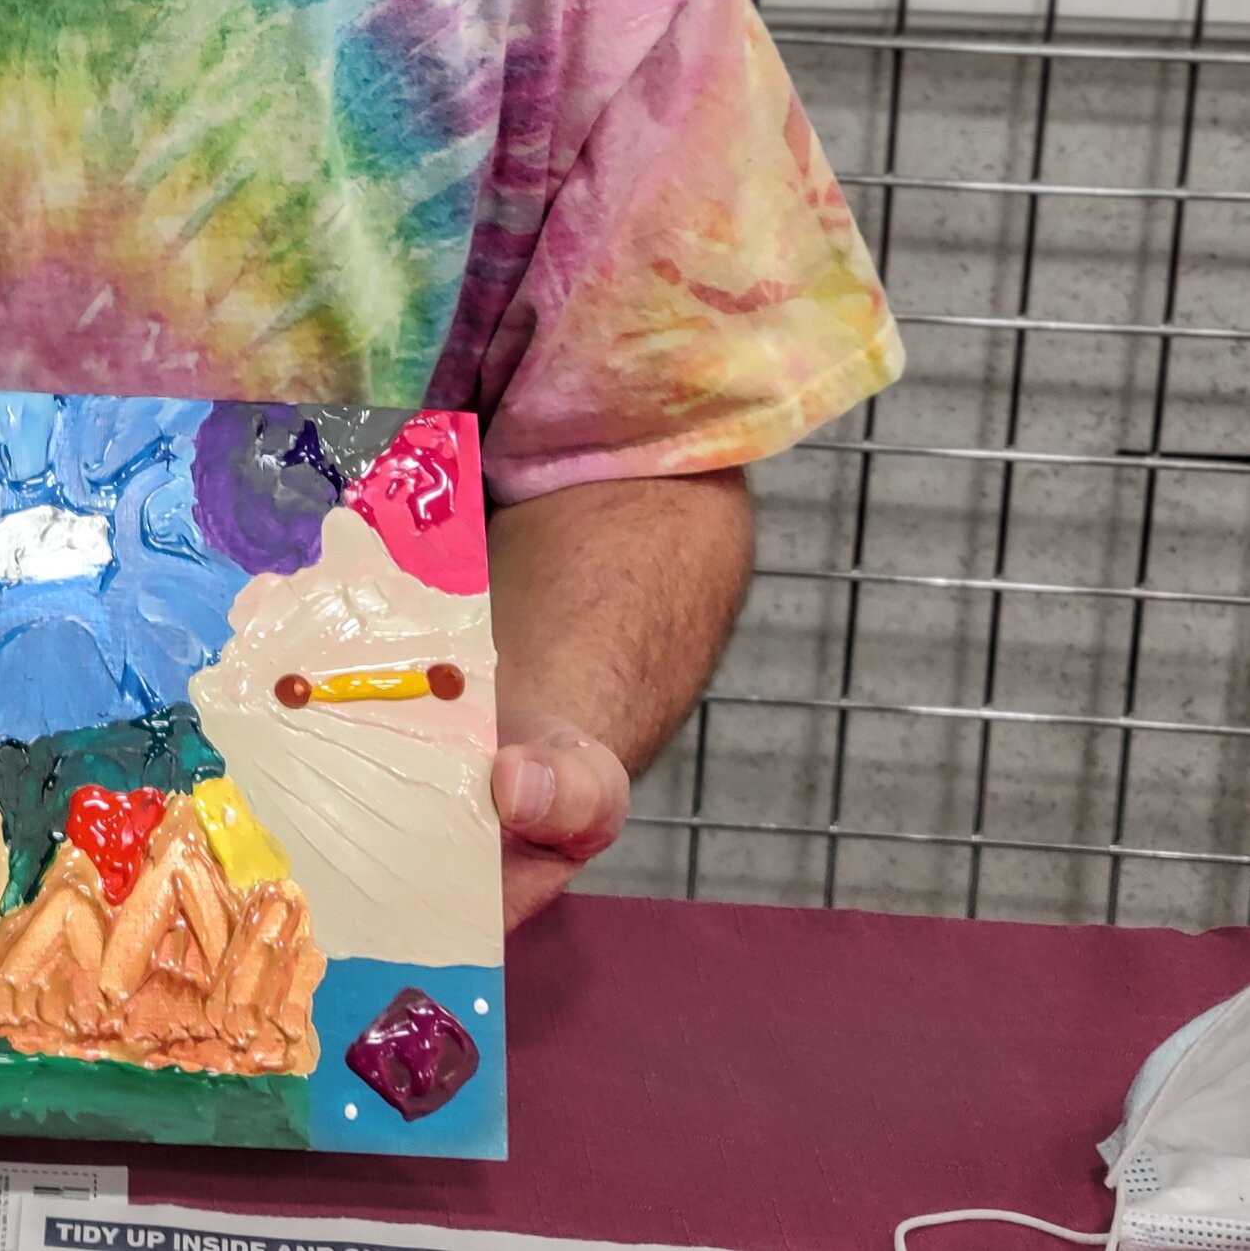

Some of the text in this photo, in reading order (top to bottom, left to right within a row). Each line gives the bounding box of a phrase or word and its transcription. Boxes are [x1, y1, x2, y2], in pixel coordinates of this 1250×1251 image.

[55, 1222, 267, 1251] TIDY UP INSIDE
